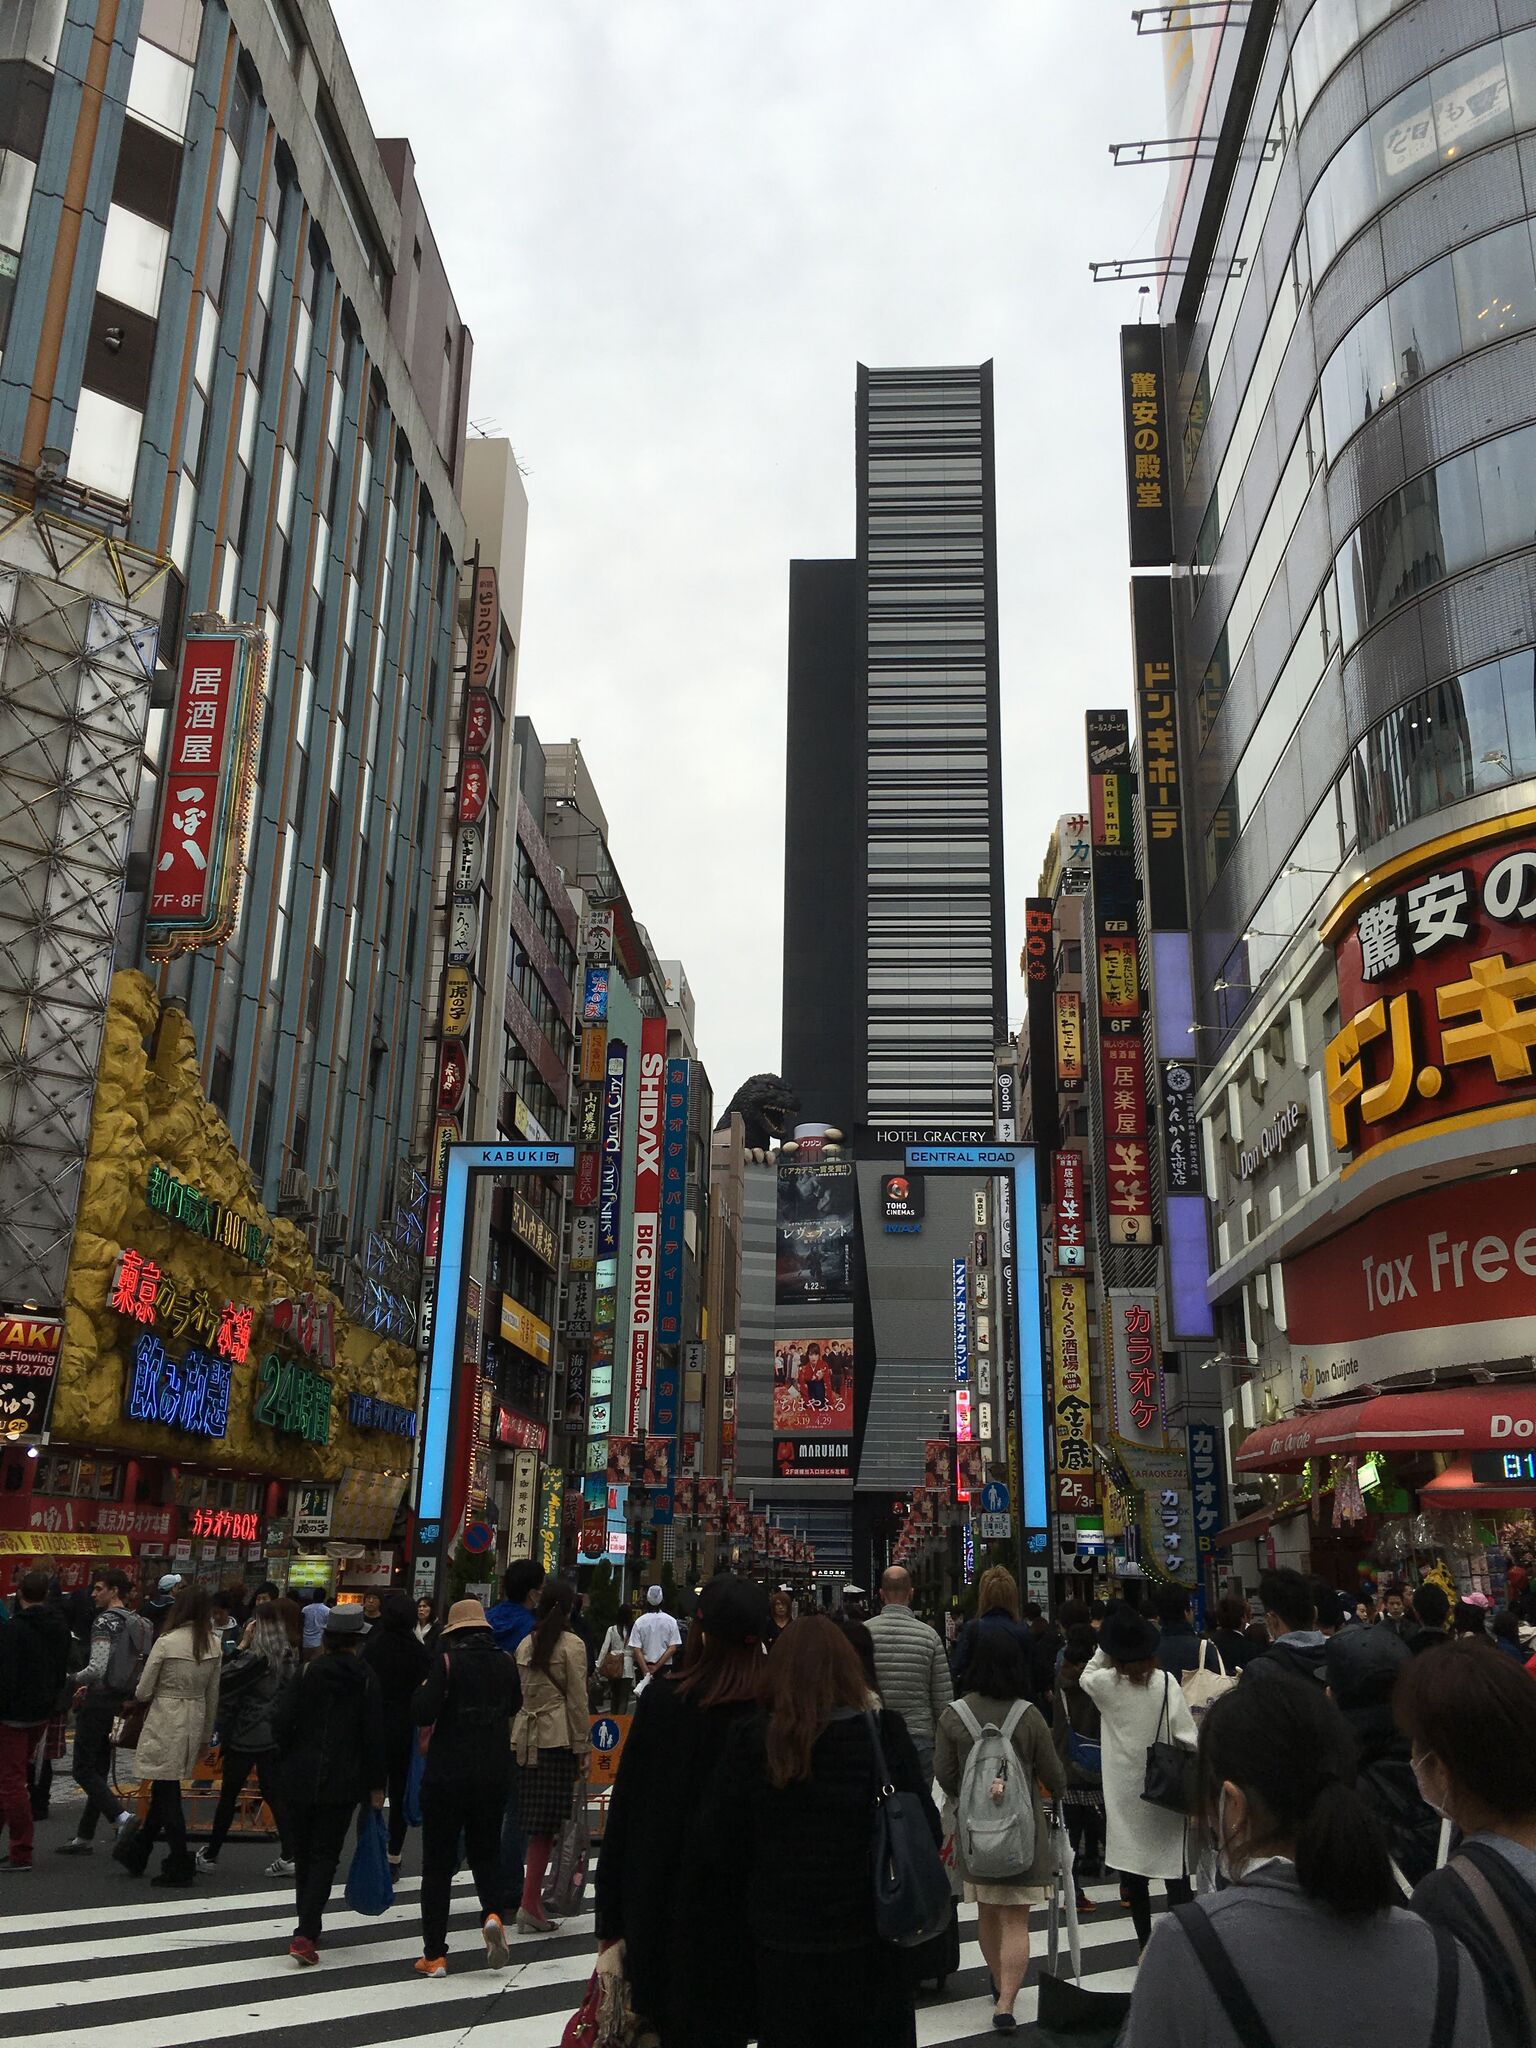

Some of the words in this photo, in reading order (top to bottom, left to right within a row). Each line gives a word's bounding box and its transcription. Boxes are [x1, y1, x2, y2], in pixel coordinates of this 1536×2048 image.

[1131, 372, 1163, 508] 驚安の殿堂
[179, 667, 222, 764] 居酒屋
[157, 787, 207, 871] つぼ八
[456, 880, 473, 890] 6F
[1107, 921, 1126, 930] 7F
[449, 986, 468, 1019] 虎の子
[445, 1025, 459, 1034] 4F
[1111, 1020, 1132, 1032] 6F
[1063, 1080, 1078, 1088] 6F
[637, 1053, 664, 1176] SHIDAX
[1113, 1066, 1138, 1134] 居楽屋
[877, 1131, 917, 1142] HOTEL
[923, 1131, 986, 1142] GRACERY
[1240, 1147, 1260, 1182] Don
[1260, 1102, 1299, 1160] Quijote
[911, 1152, 974, 1162] CENTRAL
[978, 1152, 1015, 1162] ROAD
[1109, 1143, 1147, 1213] 笑笑
[636, 1224, 653, 1260] BIC
[784, 1225, 848, 1240] レヴェナント
[956, 1265, 965, 1296] 747
[1362, 1255, 1418, 1312] Tax
[1428, 1227, 1536, 1292] Free
[633, 1265, 651, 1324] DRUG
[804, 1282, 819, 1290] 4.22
[636, 1333, 645, 1350] BIC
[957, 1303, 967, 1374] カラオケランド
[1060, 1283, 1080, 1372] きんくら酒場
[16, 1364, 54, 1377] ¥2,700
[1126, 1305, 1159, 1429] カラオケ
[1315, 1368, 1330, 1386] Don
[1331, 1359, 1360, 1382] Quijote
[130, 1335, 234, 1438] 飲み放題
[780, 1398, 846, 1412] ちはやふる
[9, 1420, 26, 1431] 2F
[816, 1416, 832, 1426] 4.29
[1056, 1394, 1093, 1471] 金の蔵
[799, 1444, 849, 1458] MARUHAN
[1060, 1477, 1083, 1497] 2F
[1193, 1431, 1218, 1530] カラオケ
[191, 1509, 258, 1540] カラオケBOX
[1161, 1489, 1185, 1571] カラオケ
